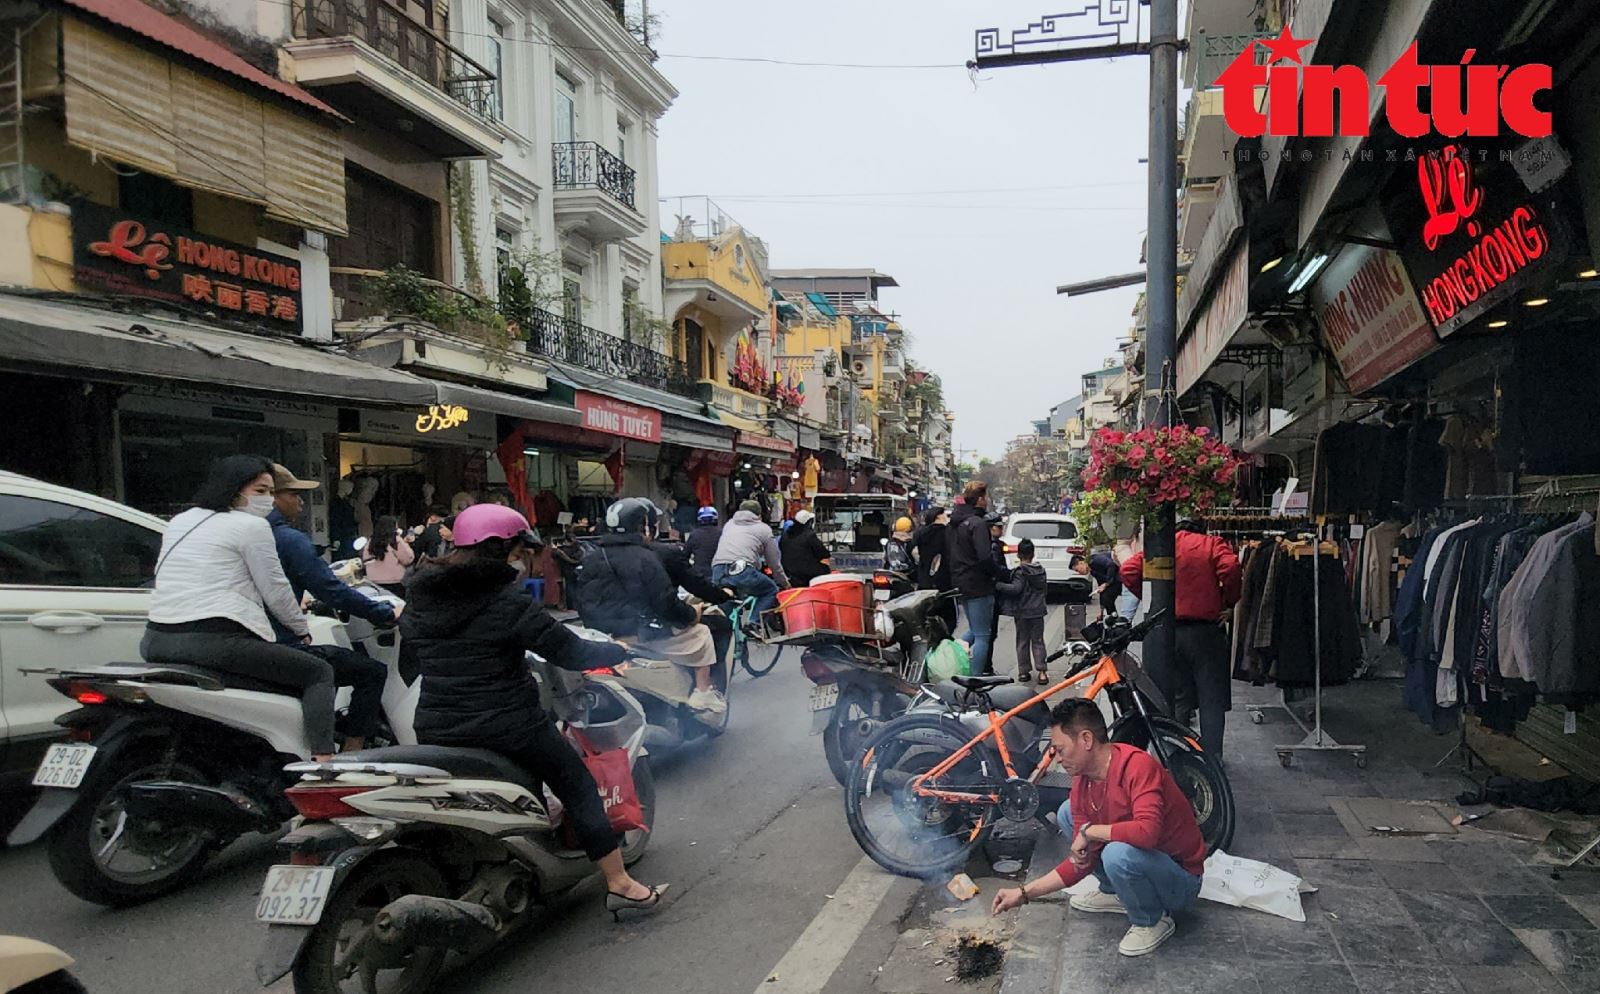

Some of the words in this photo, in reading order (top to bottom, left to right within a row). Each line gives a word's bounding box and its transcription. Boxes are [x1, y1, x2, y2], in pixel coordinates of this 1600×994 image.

[88, 220, 174, 280] Lệ
[178, 236, 240, 273] HONG
[244, 255, 299, 291] KONG
[587, 406, 620, 433] HÙNG
[37, 767, 82, 785] 026.06
[257, 896, 321, 920] 092.37
